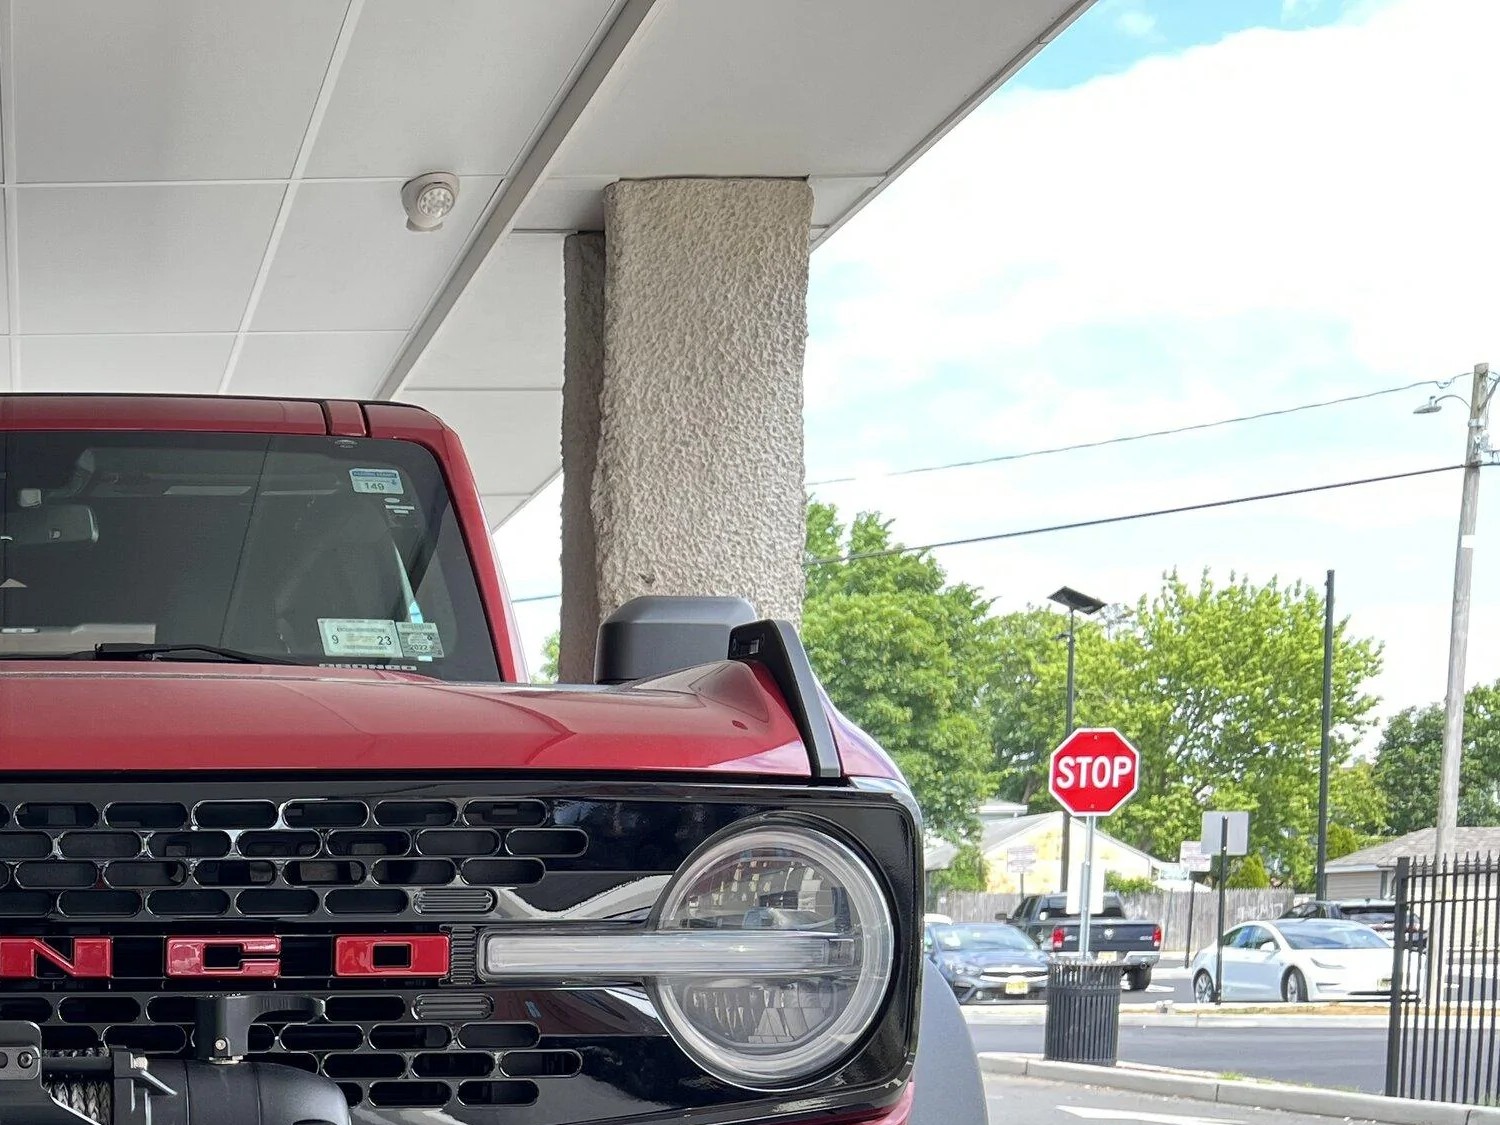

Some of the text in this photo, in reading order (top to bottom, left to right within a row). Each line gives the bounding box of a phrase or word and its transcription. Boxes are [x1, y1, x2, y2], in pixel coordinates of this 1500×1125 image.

[331, 634, 392, 646] 9 23
[1056, 755, 1133, 790] STOP
